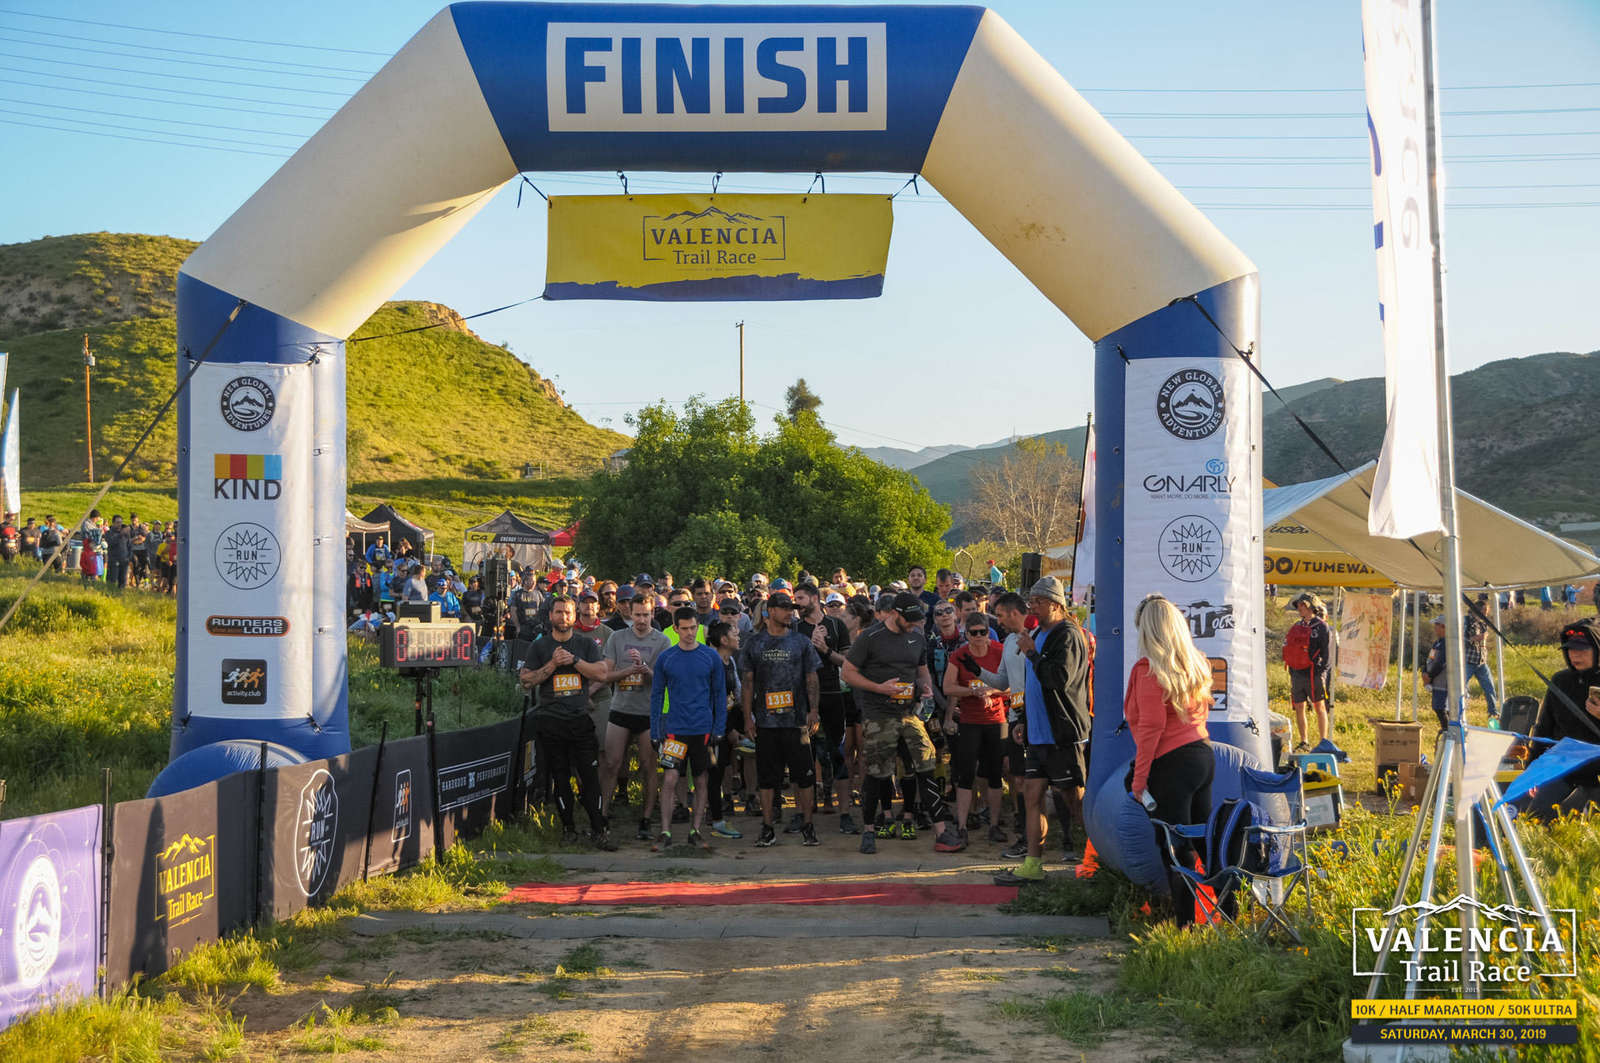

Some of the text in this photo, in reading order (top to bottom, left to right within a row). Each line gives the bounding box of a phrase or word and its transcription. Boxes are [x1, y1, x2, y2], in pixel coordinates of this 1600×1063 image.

[564, 36, 869, 115] FINISH
[651, 227, 778, 245] VALENCIA
[672, 249, 757, 264] Trail Race
[223, 378, 273, 399] NEW GLOBAL
[1162, 371, 1223, 398] NEW GLOBAL
[225, 409, 273, 430] ADVENTURES
[1161, 411, 1223, 438] ADVENTURES
[214, 479, 282, 500] KIND
[1143, 474, 1236, 494] GNARLY
[236, 550, 258, 561] RUN
[1181, 542, 1203, 553] RUN
[212, 618, 283, 627] RUNNERS
[243, 626, 283, 634] LANE
[767, 693, 792, 706] 1313
[158, 853, 212, 896] VALENCIA
[167, 891, 204, 921] Trail Race
